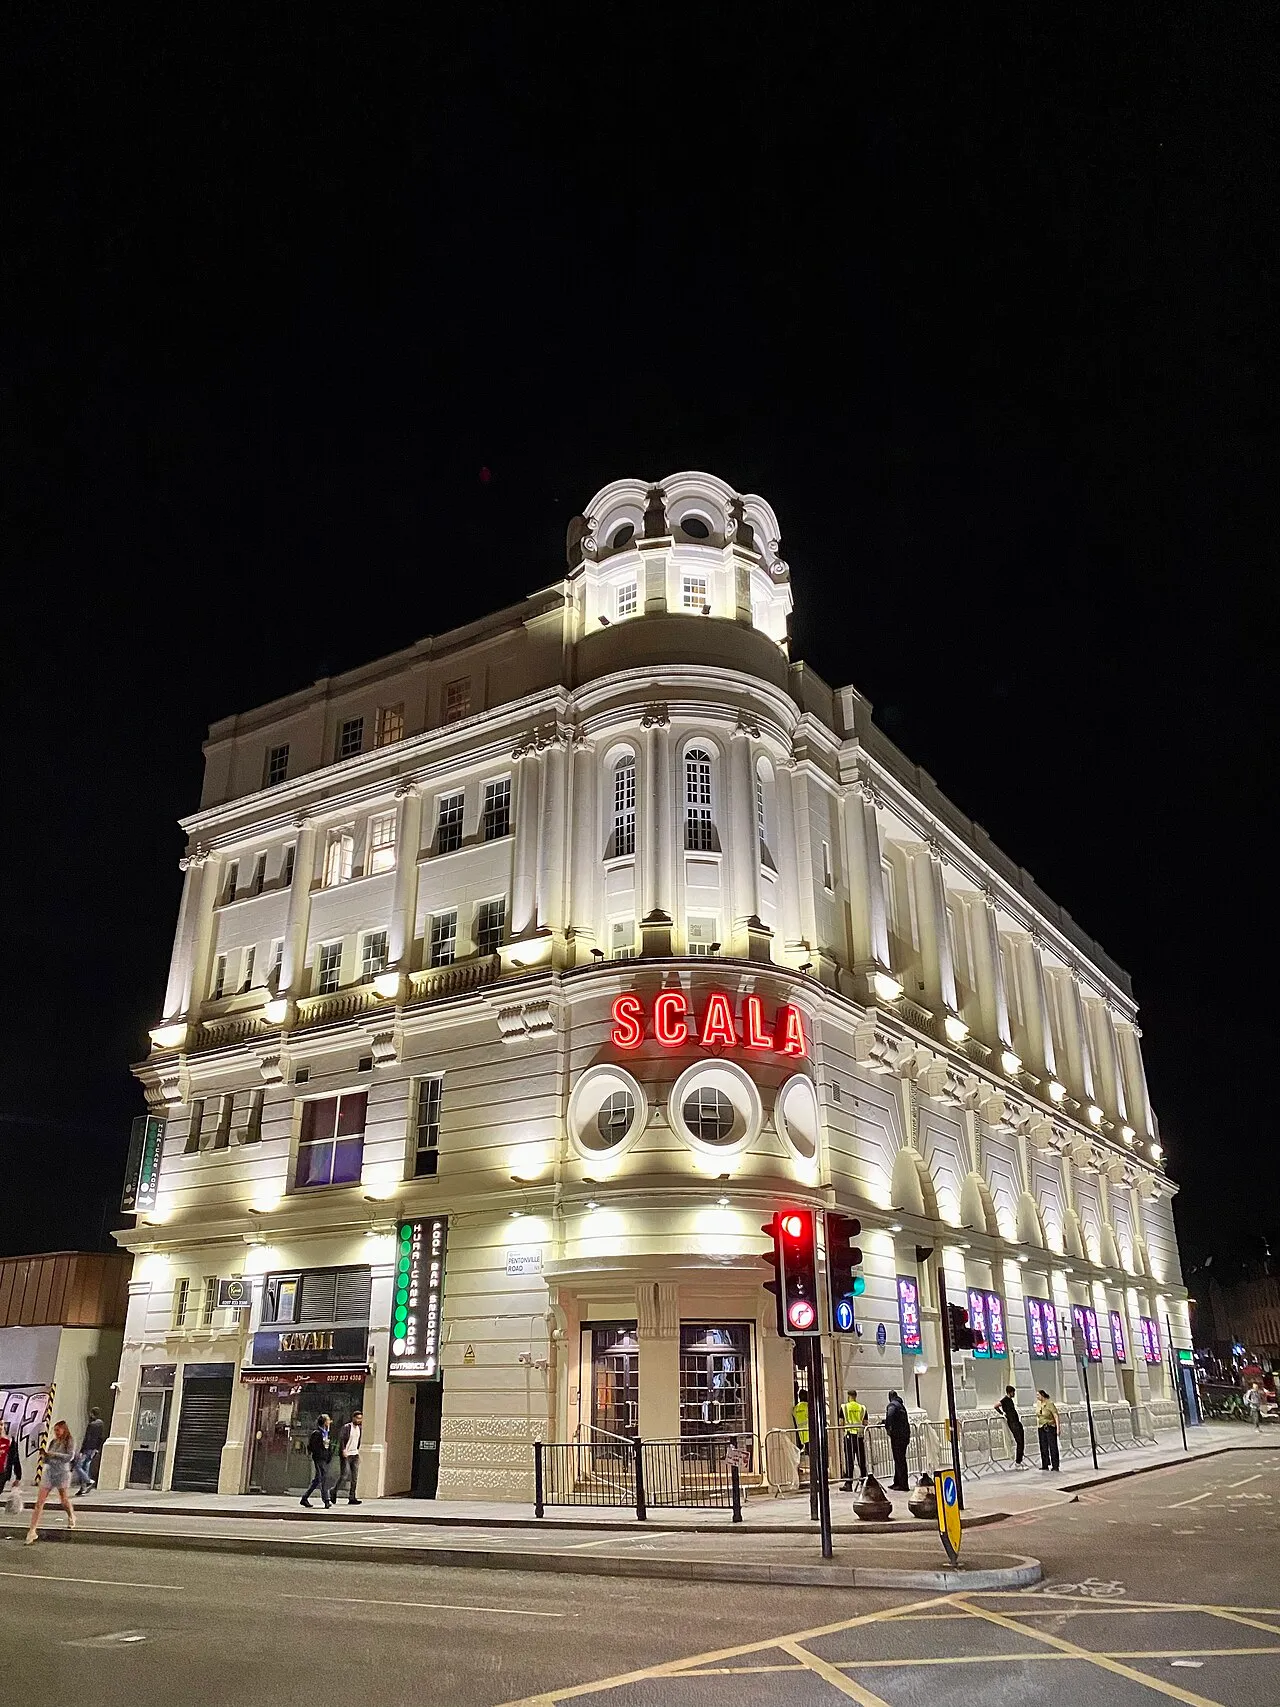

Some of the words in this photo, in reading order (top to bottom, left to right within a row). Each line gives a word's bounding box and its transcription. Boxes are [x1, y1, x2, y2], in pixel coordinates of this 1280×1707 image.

[611, 991, 807, 1058] SCALA
[153, 1124, 163, 1167] HURRICANE
[149, 1173, 157, 1192] ROOM
[432, 1222, 441, 1255] POOL
[409, 1223, 422, 1308] HURRICANE
[429, 1262, 440, 1287] BAR
[508, 1256, 540, 1264] PENTONVILLE
[405, 1316, 417, 1355] ROOM
[425, 1294, 439, 1355] SNOOKER
[389, 1362, 425, 1370] ENTRANCE
